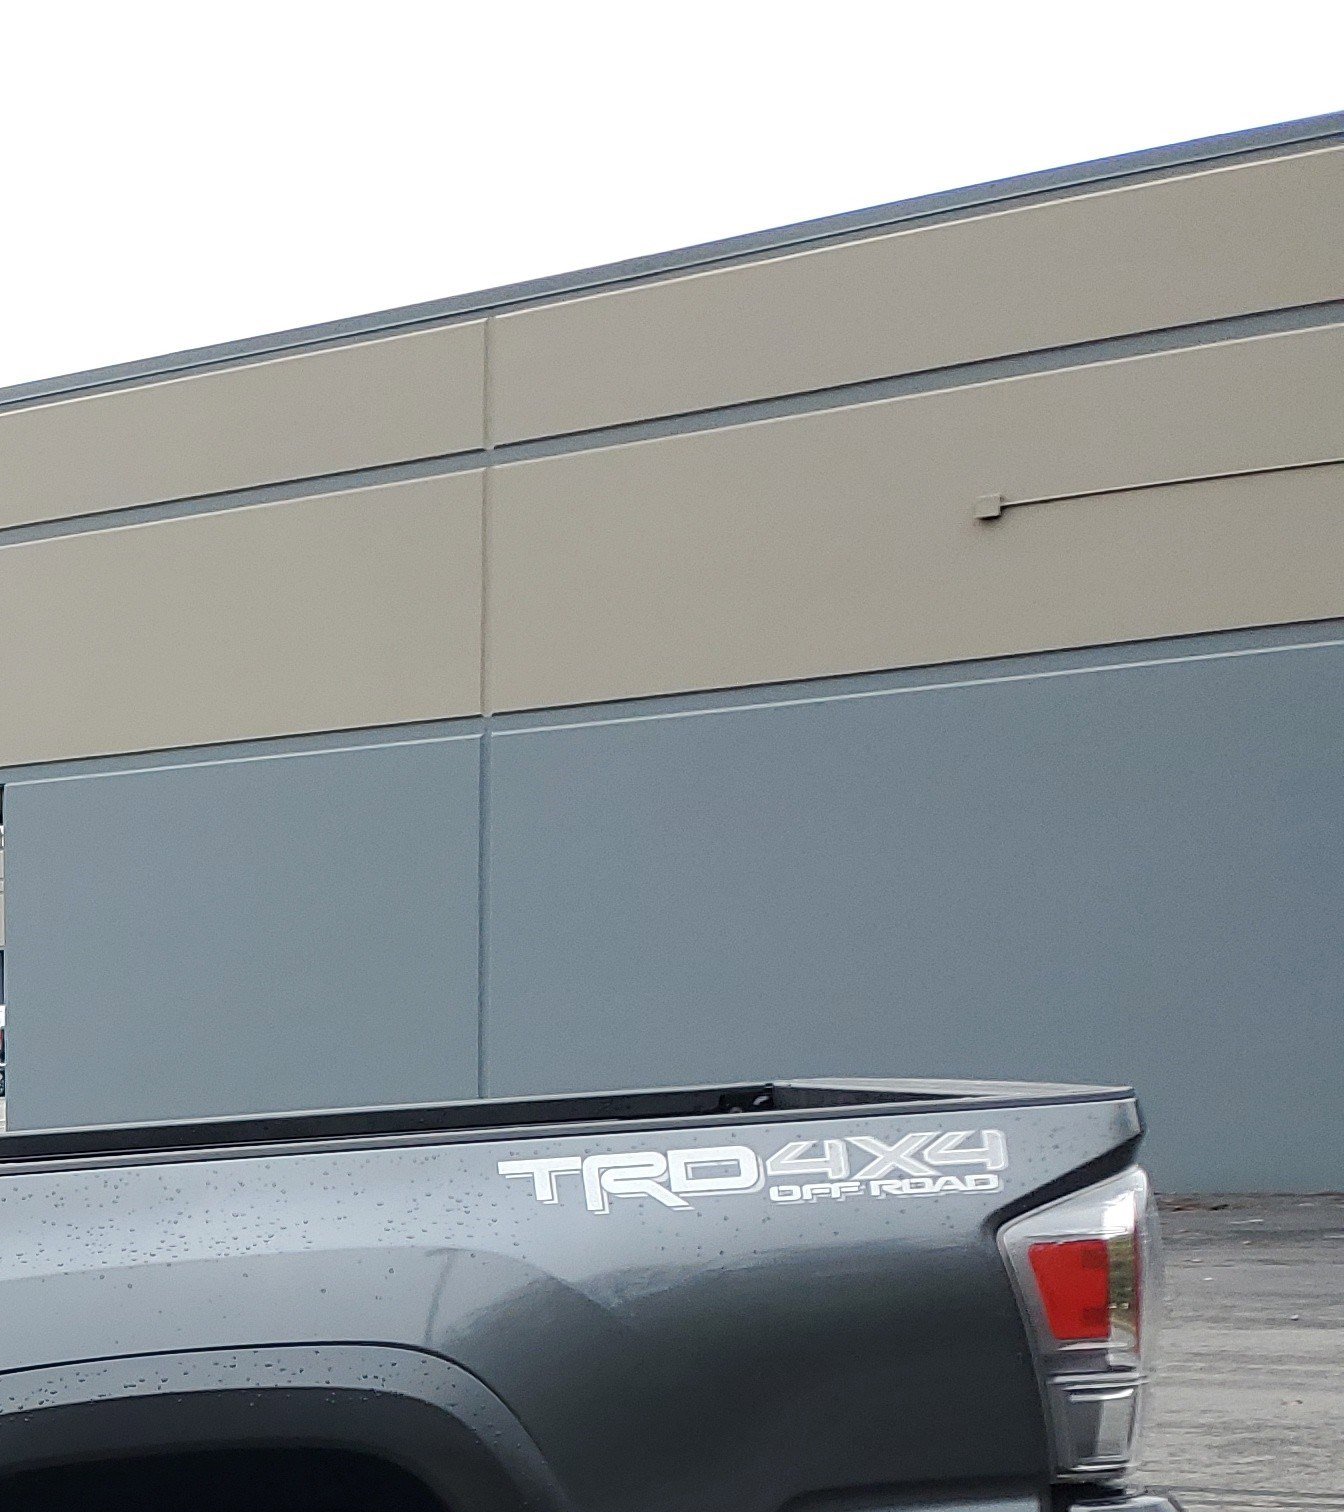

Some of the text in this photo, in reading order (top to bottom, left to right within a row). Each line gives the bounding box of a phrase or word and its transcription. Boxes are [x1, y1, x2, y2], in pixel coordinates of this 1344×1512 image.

[498, 1129, 1010, 1214] TRD 4X4
[768, 1174, 1006, 1204] OFF ROAD
